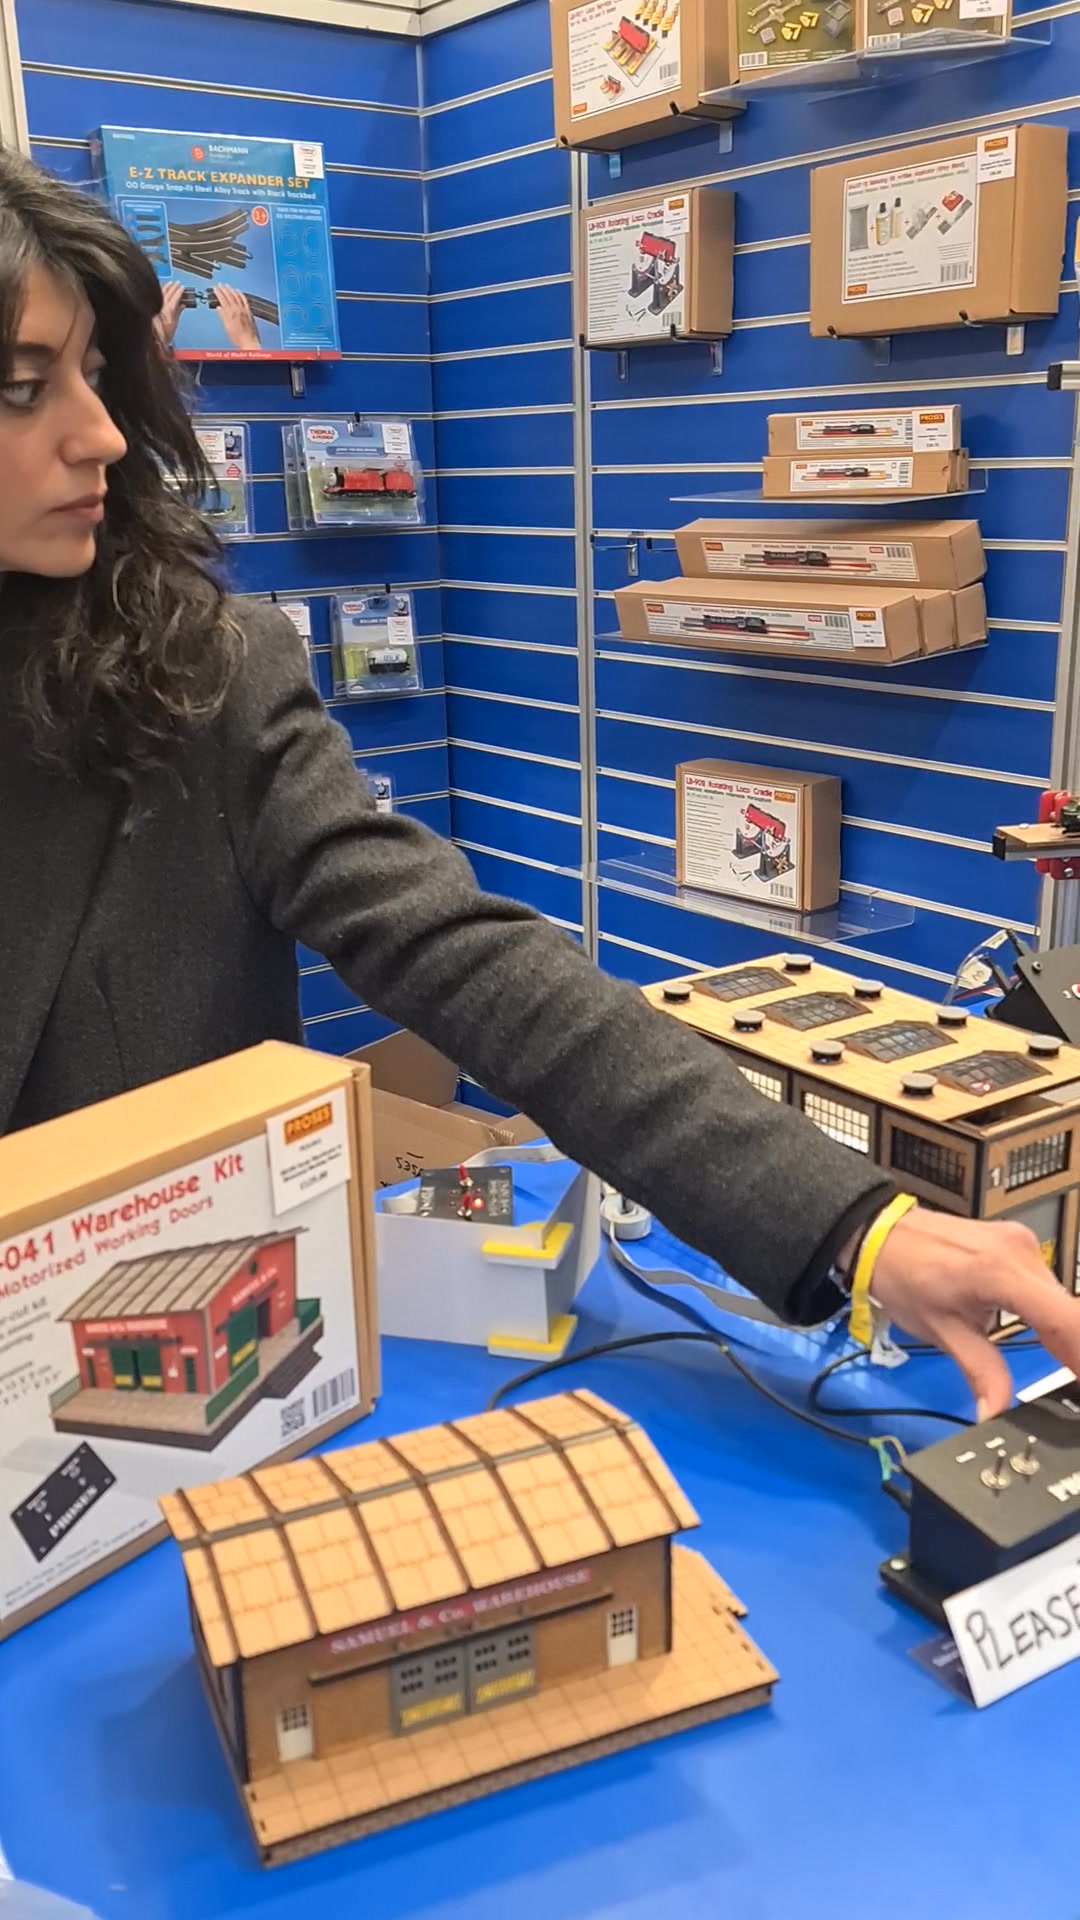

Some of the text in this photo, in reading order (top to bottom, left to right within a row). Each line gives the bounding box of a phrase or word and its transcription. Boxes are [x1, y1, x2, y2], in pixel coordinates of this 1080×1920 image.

[128, 166, 310, 189] E-Z TRACK EXPANDER SET
[140, 182, 164, 191] Gauge
[214, 187, 231, 195] Alloy
[232, 187, 250, 195] Track
[647, 210, 664, 219] Cradle
[708, 781, 733, 792] Rotating
[736, 785, 751, 794] Loco
[753, 787, 772, 797] Cradle
[286, 1107, 331, 1135] PROSES
[71, 1174, 200, 1243] Warehouse
[213, 1153, 244, 1183] Kit
[0, 1196, 214, 1298] Motorized Working Doors
[330, 1620, 410, 1654] SAMUEL
[416, 1613, 433, 1629] &
[472, 1567, 591, 1612] WAREHOUSE
[965, 1584, 1080, 1670] PLEASE
